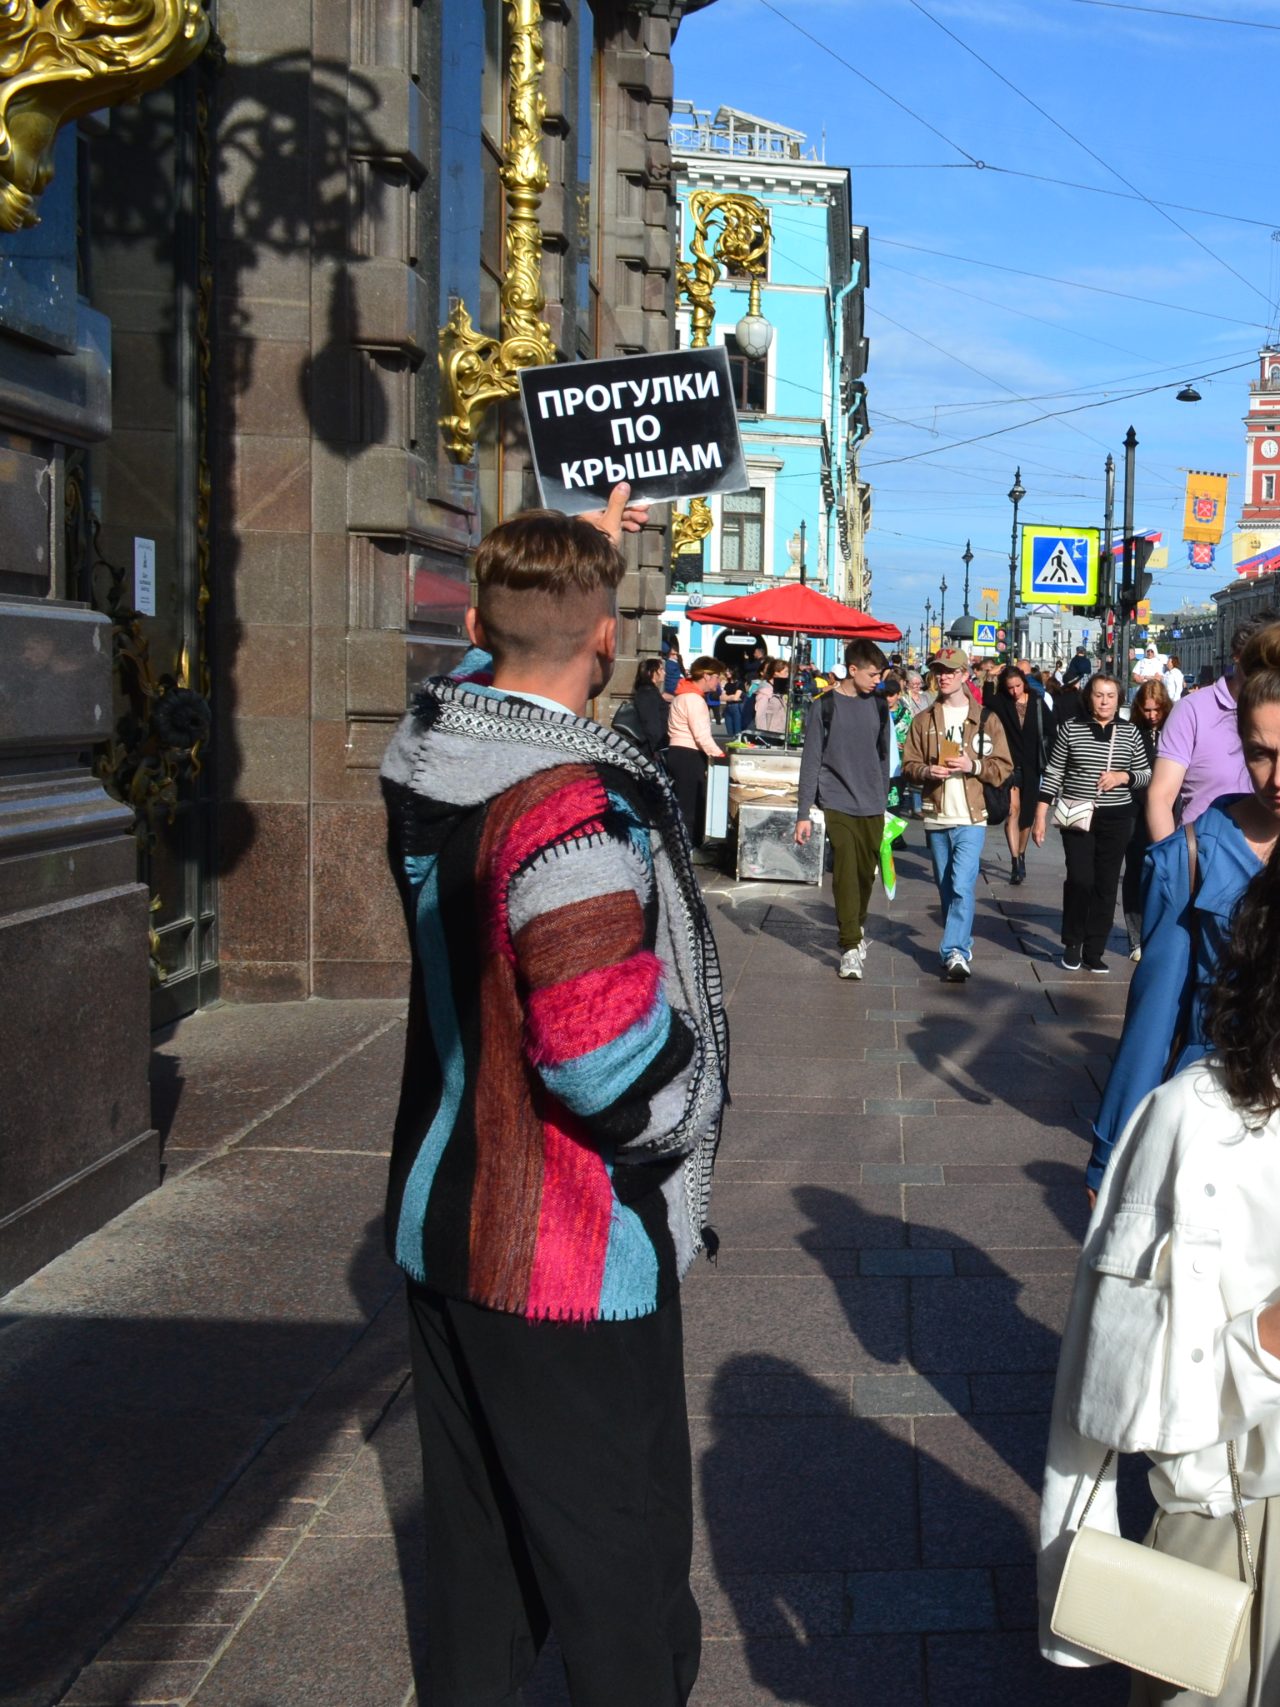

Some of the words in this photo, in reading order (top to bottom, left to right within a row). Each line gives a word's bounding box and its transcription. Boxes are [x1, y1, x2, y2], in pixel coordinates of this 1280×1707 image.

[537, 371, 720, 419] ПРОГУЛКИ
[610, 414, 661, 446] ПО
[560, 441, 722, 489] КРЫШАМ
